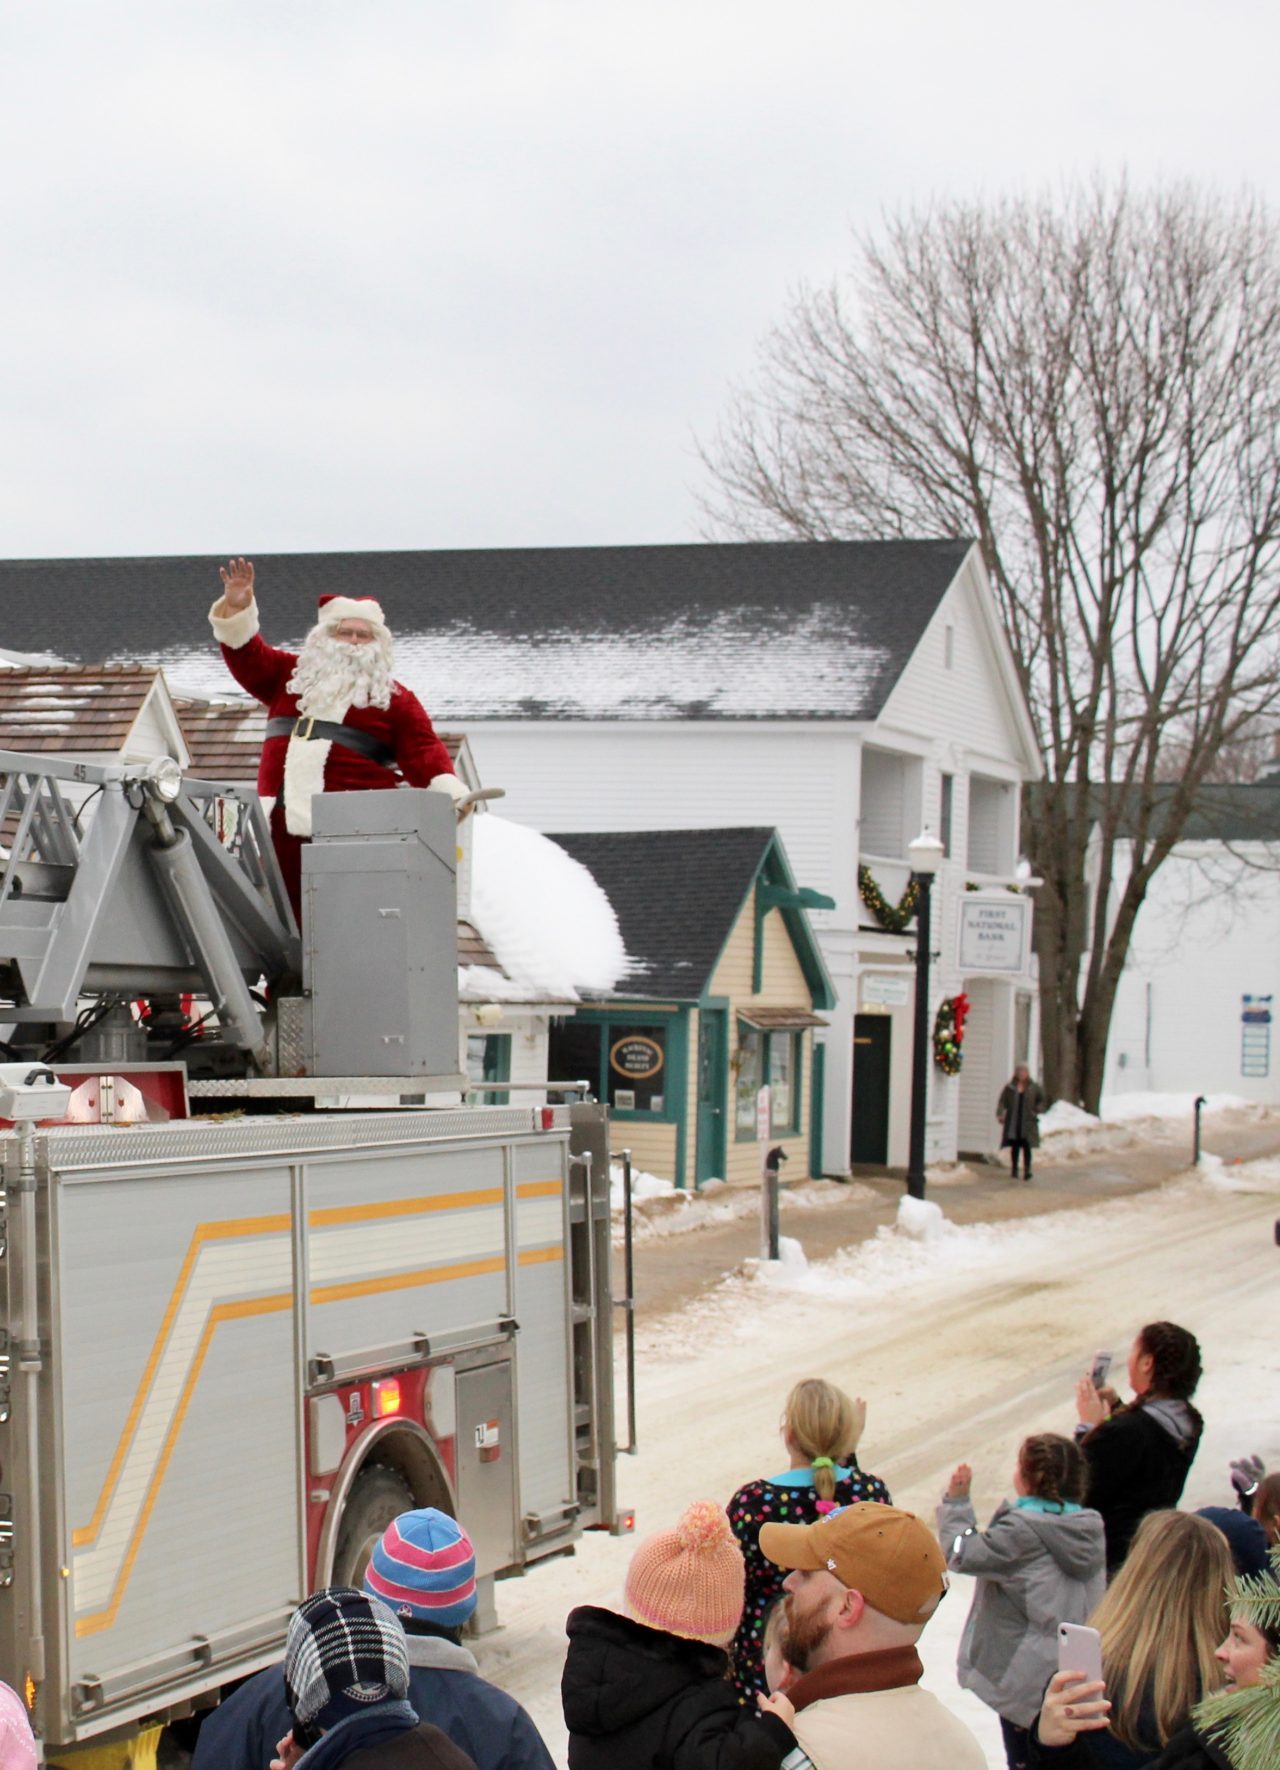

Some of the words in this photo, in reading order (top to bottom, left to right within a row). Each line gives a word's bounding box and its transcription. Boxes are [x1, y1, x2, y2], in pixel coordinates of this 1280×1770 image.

[73, 763, 86, 782] 45
[978, 909, 1007, 919] FIRST
[967, 920, 1017, 931] NATIONAL
[977, 932, 1005, 942] BANK
